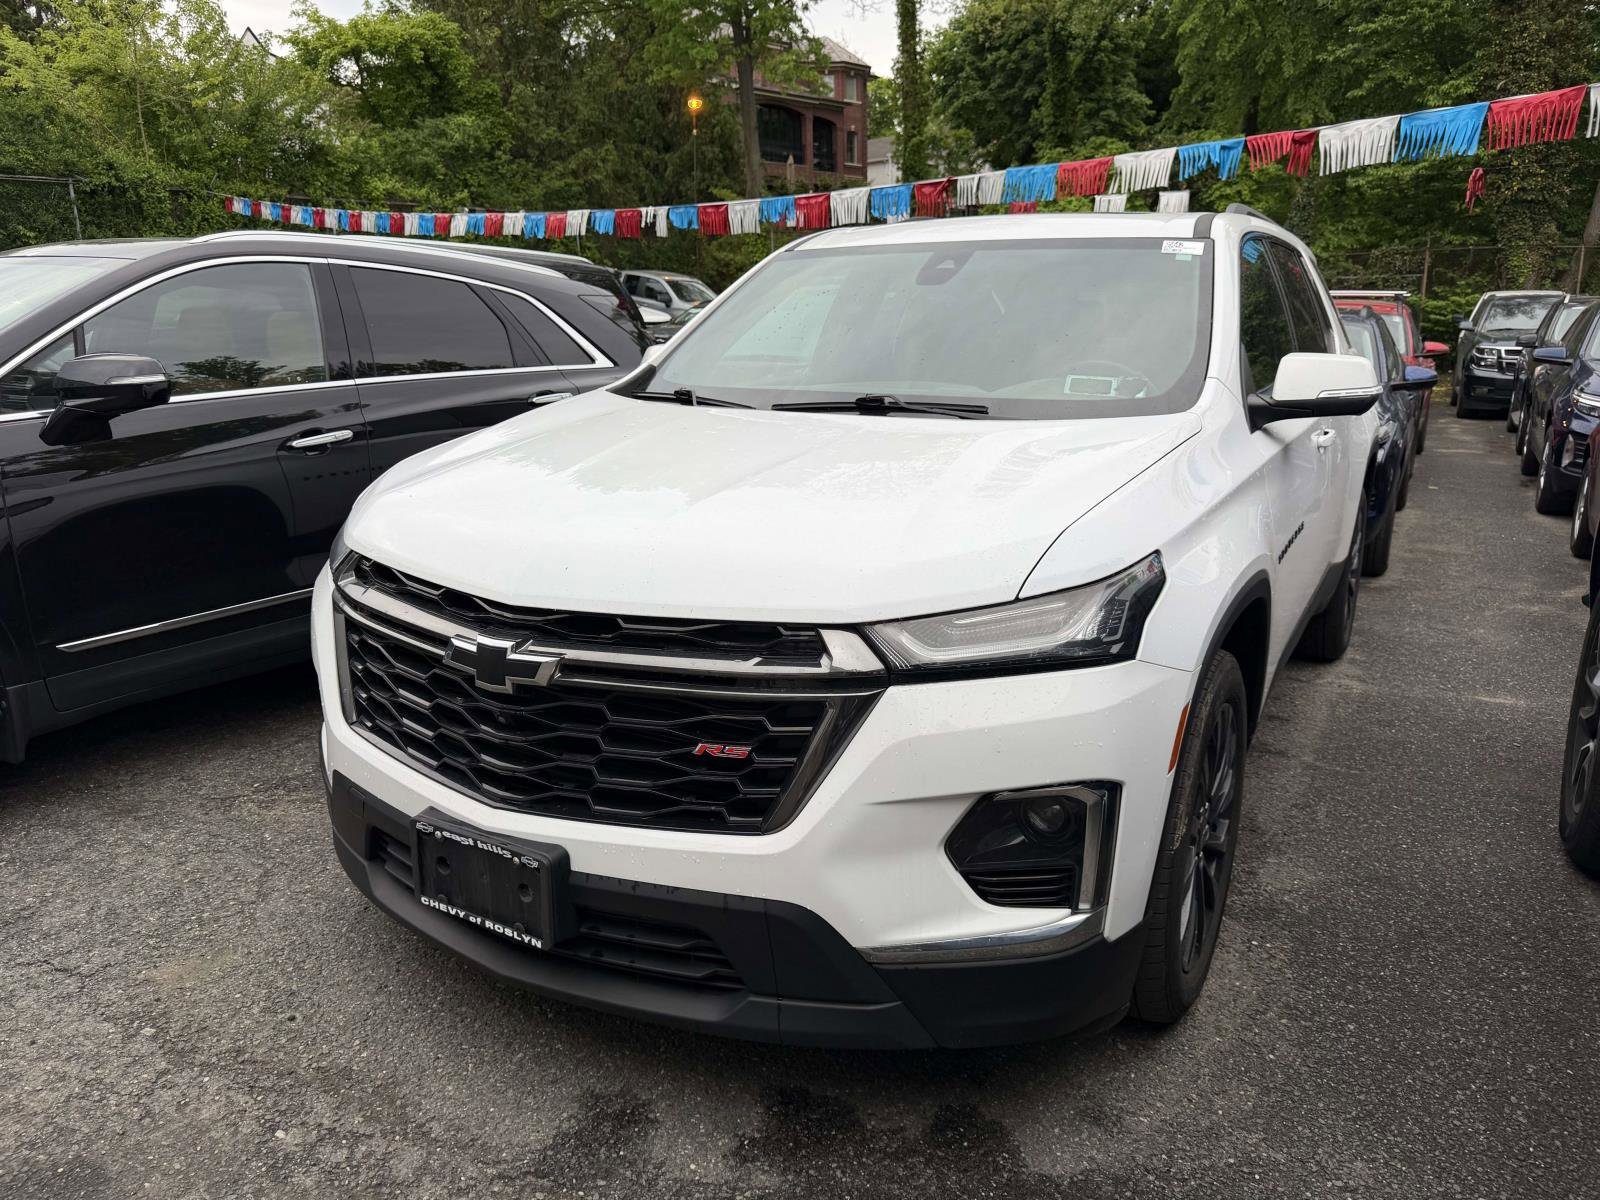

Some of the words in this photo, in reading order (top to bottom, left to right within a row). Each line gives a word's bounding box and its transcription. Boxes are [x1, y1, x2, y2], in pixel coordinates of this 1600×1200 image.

[691, 743, 752, 759] RS
[442, 830, 475, 847] east
[476, 840, 513, 859] hills
[420, 896, 466, 919] CHEVY
[469, 916, 482, 926] of
[484, 920, 543, 949] ROSLYN
